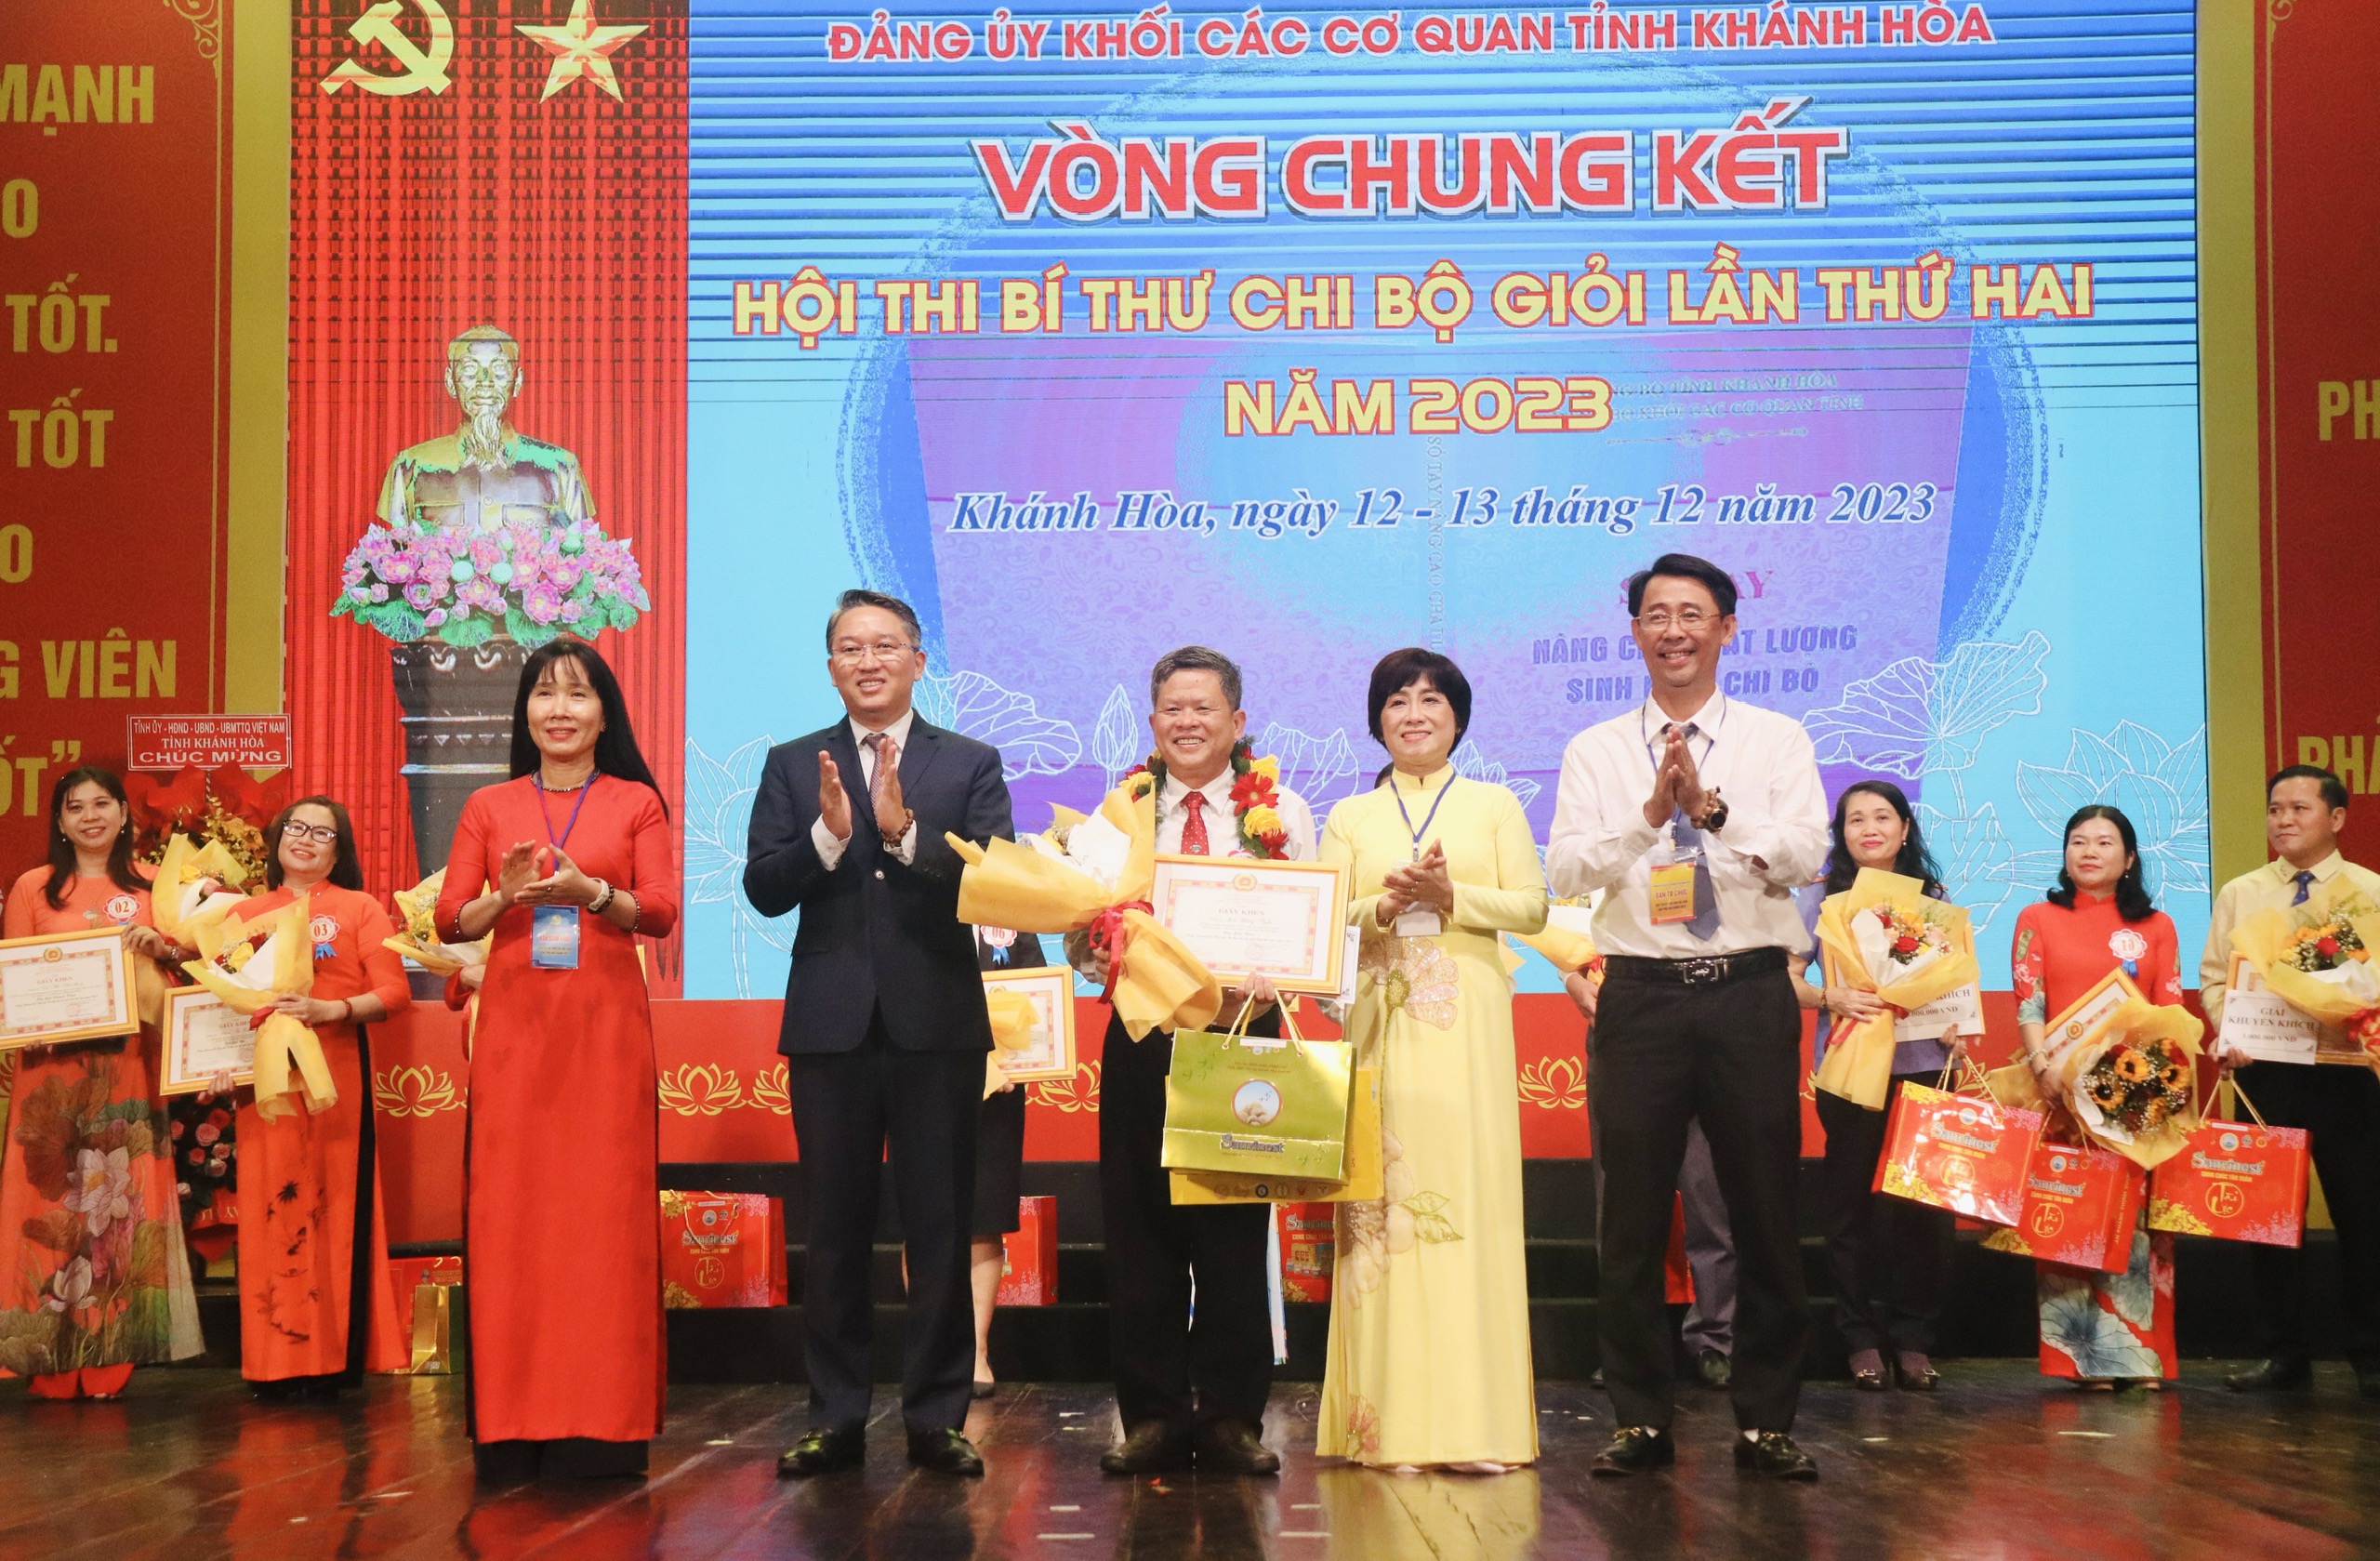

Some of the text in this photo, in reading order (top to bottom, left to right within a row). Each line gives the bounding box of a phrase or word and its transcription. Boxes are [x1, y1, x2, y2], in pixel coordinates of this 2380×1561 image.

[827, 0, 1997, 62] ĐẢNG ỦY KHỐI CÁC CƠ QUAN TỈNH KHÁNH HÒA
[969, 96, 1850, 223] VÒNG CHUNG KẾT
[5, 273, 118, 353] TỐT.
[733, 241, 2096, 350] HỘI THI BÍ THƯ CHI BỘ GIỎI LẦN THỨ HAI
[1223, 366, 1613, 437] NĂM 2023
[8, 389, 113, 468] TỐT
[945, 490, 1100, 534] Khánh
[1108, 490, 1218, 538] Hòa,
[1229, 488, 1339, 540] ngày
[1348, 488, 1405, 529] 12
[1443, 485, 1501, 528] 13
[1509, 483, 1641, 536] tháng
[1650, 484, 1706, 527] 12
[1716, 482, 1816, 524] năm
[1825, 482, 1937, 524] 2023
[41, 628, 177, 698] VIÊN
[1534, 633, 1607, 664] NÂNG
[1766, 624, 1858, 657] LƯỢNG
[1567, 678, 1633, 704] SINH
[1724, 668, 1770, 695] CHI
[1782, 663, 1819, 694] BỘ
[193, 735, 236, 748] KHÁNH
[240, 734, 264, 748] HÒA
[194, 722, 215, 734] UBND
[220, 721, 250, 734] UBMTTQ
[270, 721, 284, 734] NAM
[139, 749, 204, 762] CHÚC
[114, 901, 129, 914] 02
[313, 923, 328, 937] 03
[2191, 1150, 2266, 1176] Sanvinest
